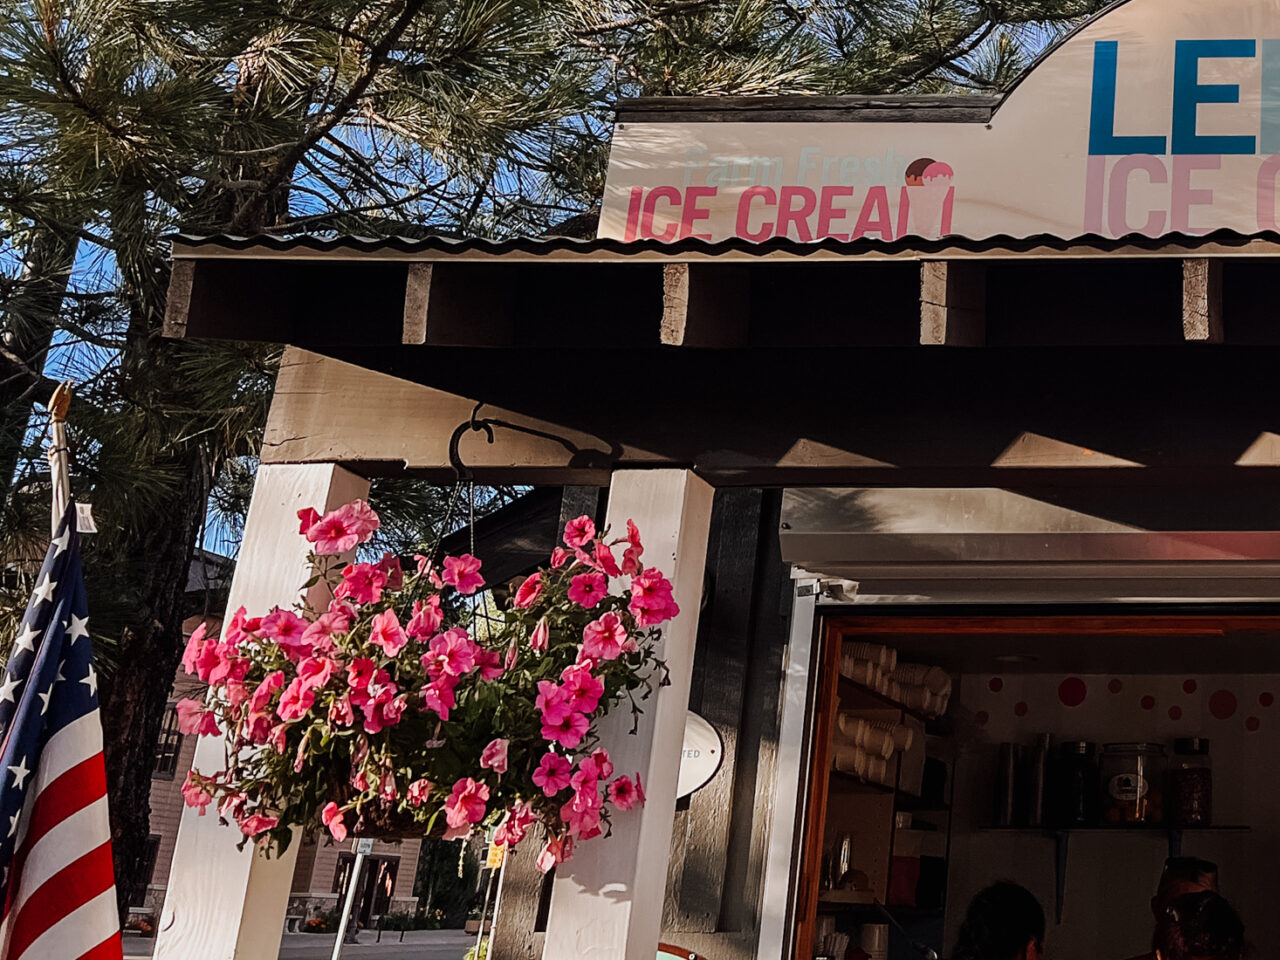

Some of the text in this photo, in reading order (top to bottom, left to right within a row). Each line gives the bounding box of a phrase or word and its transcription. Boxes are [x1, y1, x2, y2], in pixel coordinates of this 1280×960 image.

[683, 146, 907, 188] Farm Fresh
[1083, 153, 1221, 239] ICE
[624, 185, 717, 243] ICE
